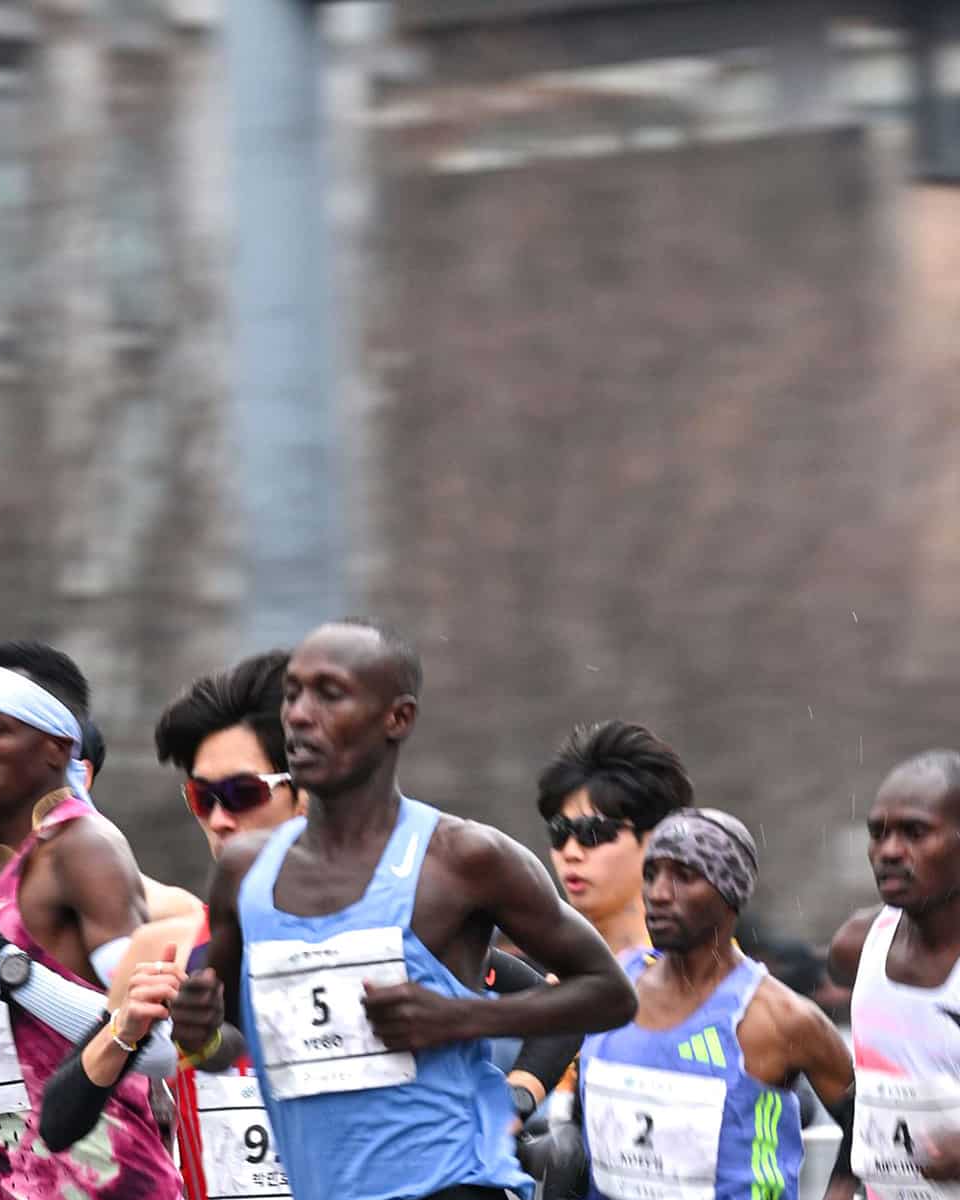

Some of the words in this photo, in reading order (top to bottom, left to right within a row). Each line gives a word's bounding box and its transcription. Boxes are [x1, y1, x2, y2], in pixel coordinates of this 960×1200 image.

[312, 987, 330, 1026] 5
[634, 1112, 653, 1149] 2
[893, 1119, 913, 1157] 4
